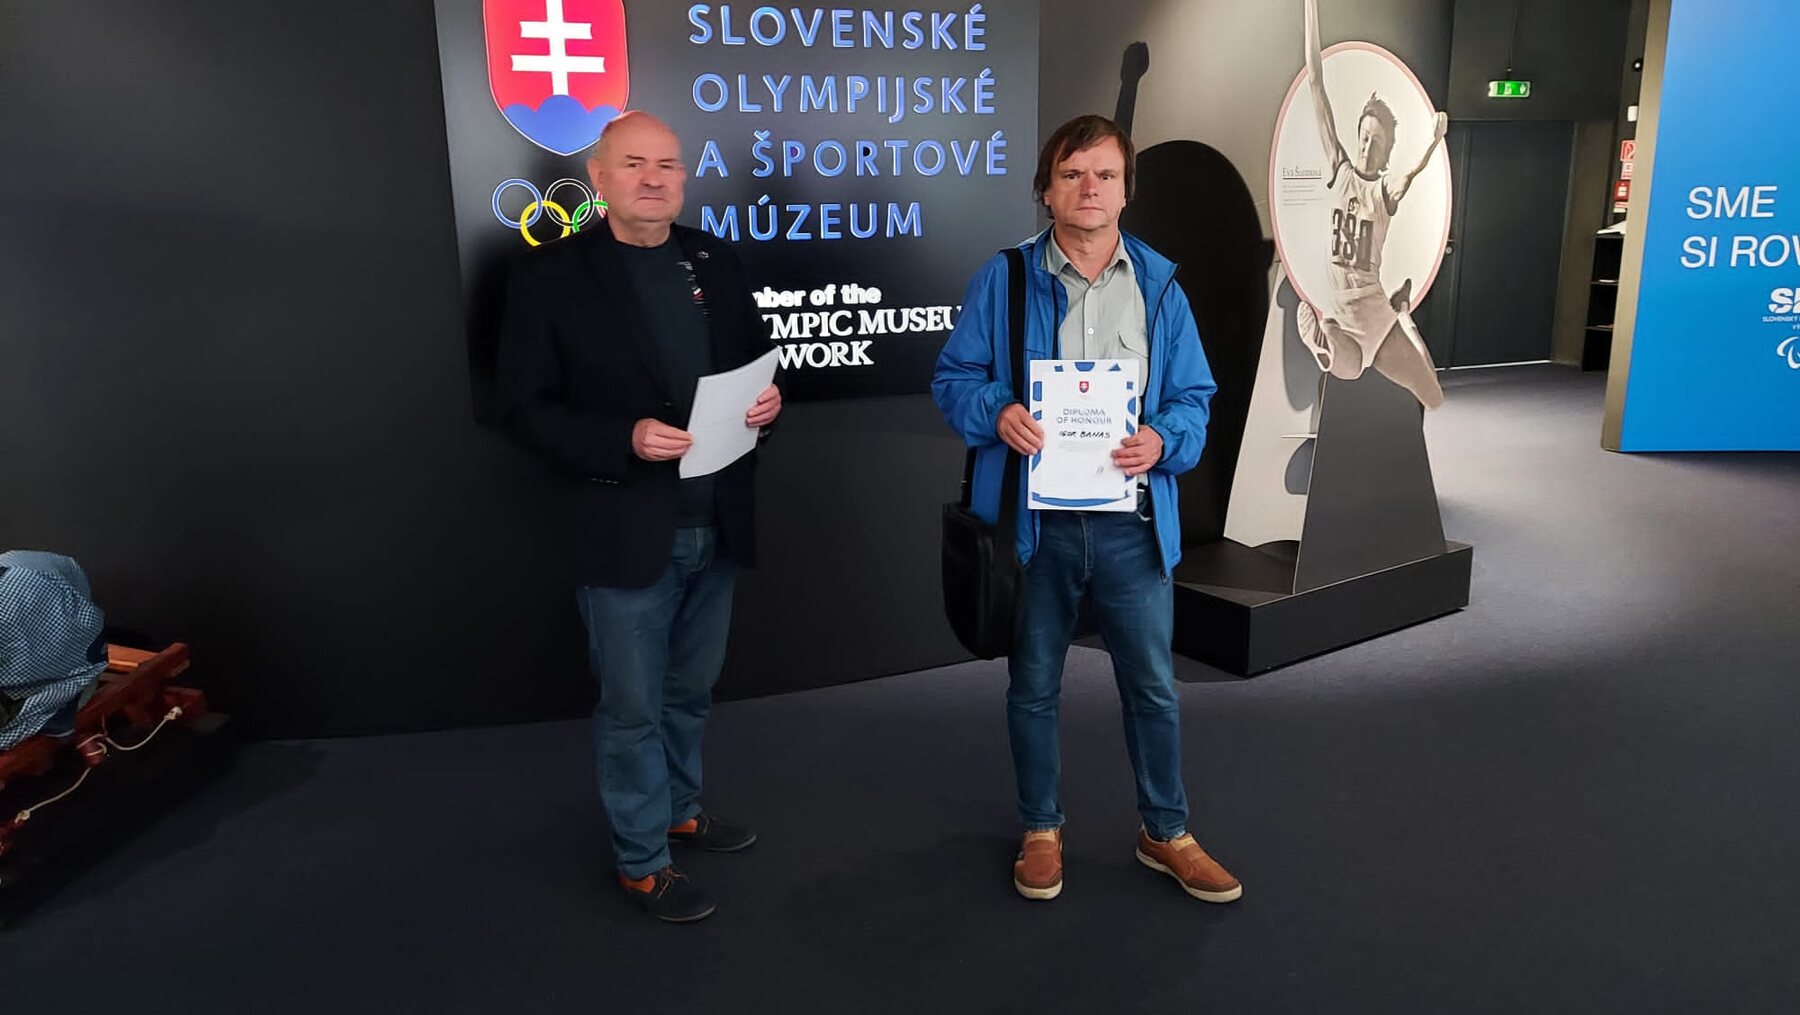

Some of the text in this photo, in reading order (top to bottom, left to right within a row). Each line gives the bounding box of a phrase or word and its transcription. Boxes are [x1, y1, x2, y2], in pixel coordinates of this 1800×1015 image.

[688, 3, 987, 51] SLOVENSKÉ
[692, 67, 996, 124] OLYMPIJSKÉ
[695, 129, 1009, 178] A ŠPORTOVÉ
[701, 194, 923, 242] MÚZEUM
[1685, 185, 1778, 219] SME
[1680, 235, 1718, 268] SI
[809, 284, 836, 306] of
[841, 283, 882, 304] the
[762, 305, 962, 339] MPIC MUSEU
[1057, 416, 1112, 425] OF HONOUR
[1063, 408, 1106, 416] DIPLOMA
